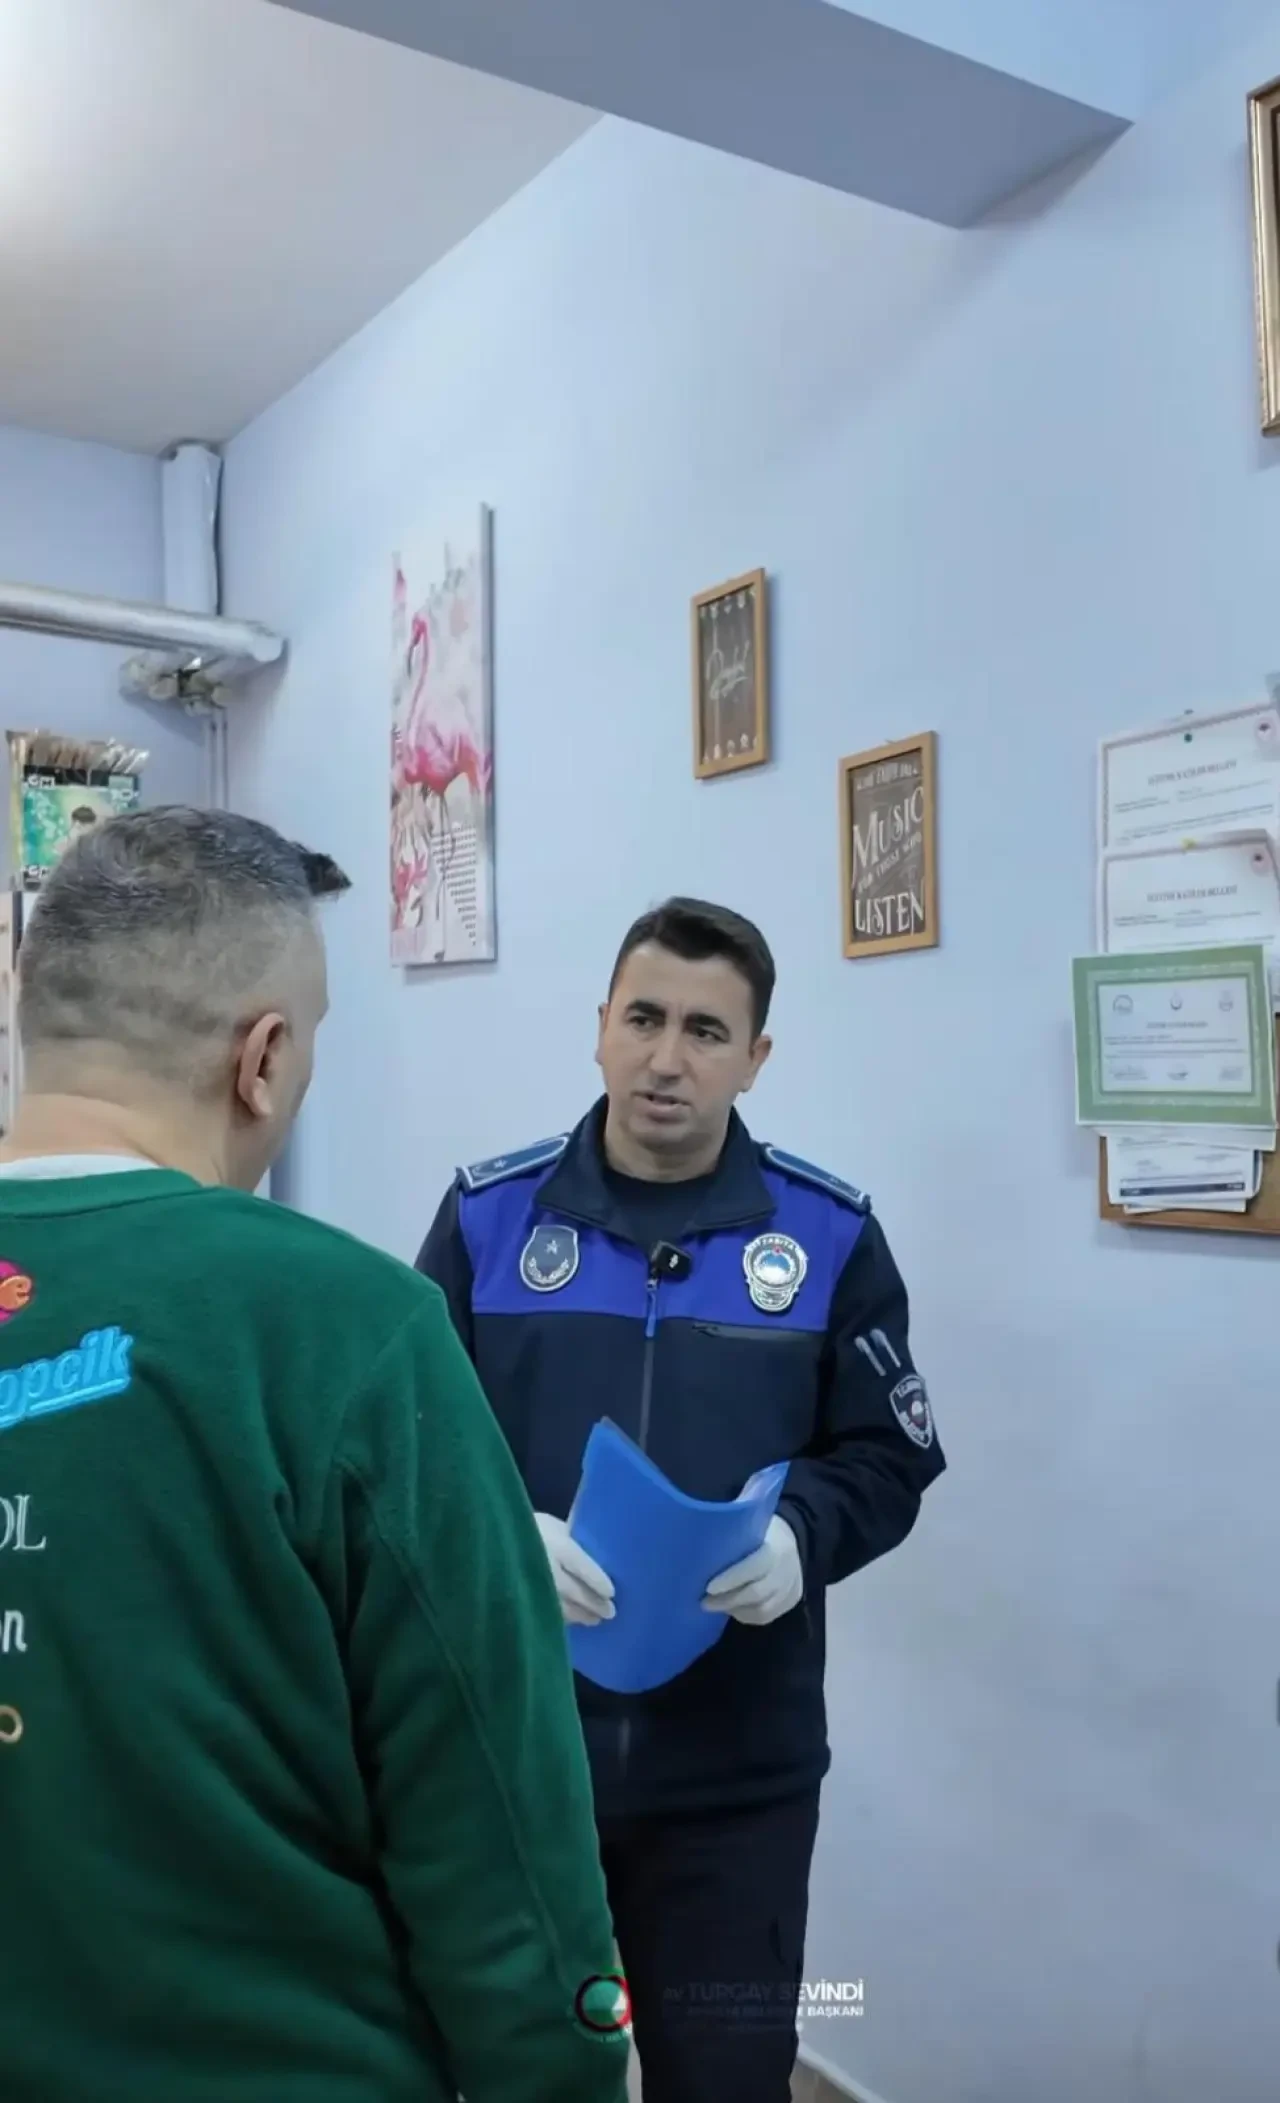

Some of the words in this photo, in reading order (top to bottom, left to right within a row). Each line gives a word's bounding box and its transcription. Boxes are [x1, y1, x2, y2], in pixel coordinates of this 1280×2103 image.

[851, 786, 924, 890] MUSIC
[854, 878, 925, 936] LISTEN
[0, 1609, 28, 1653] n
